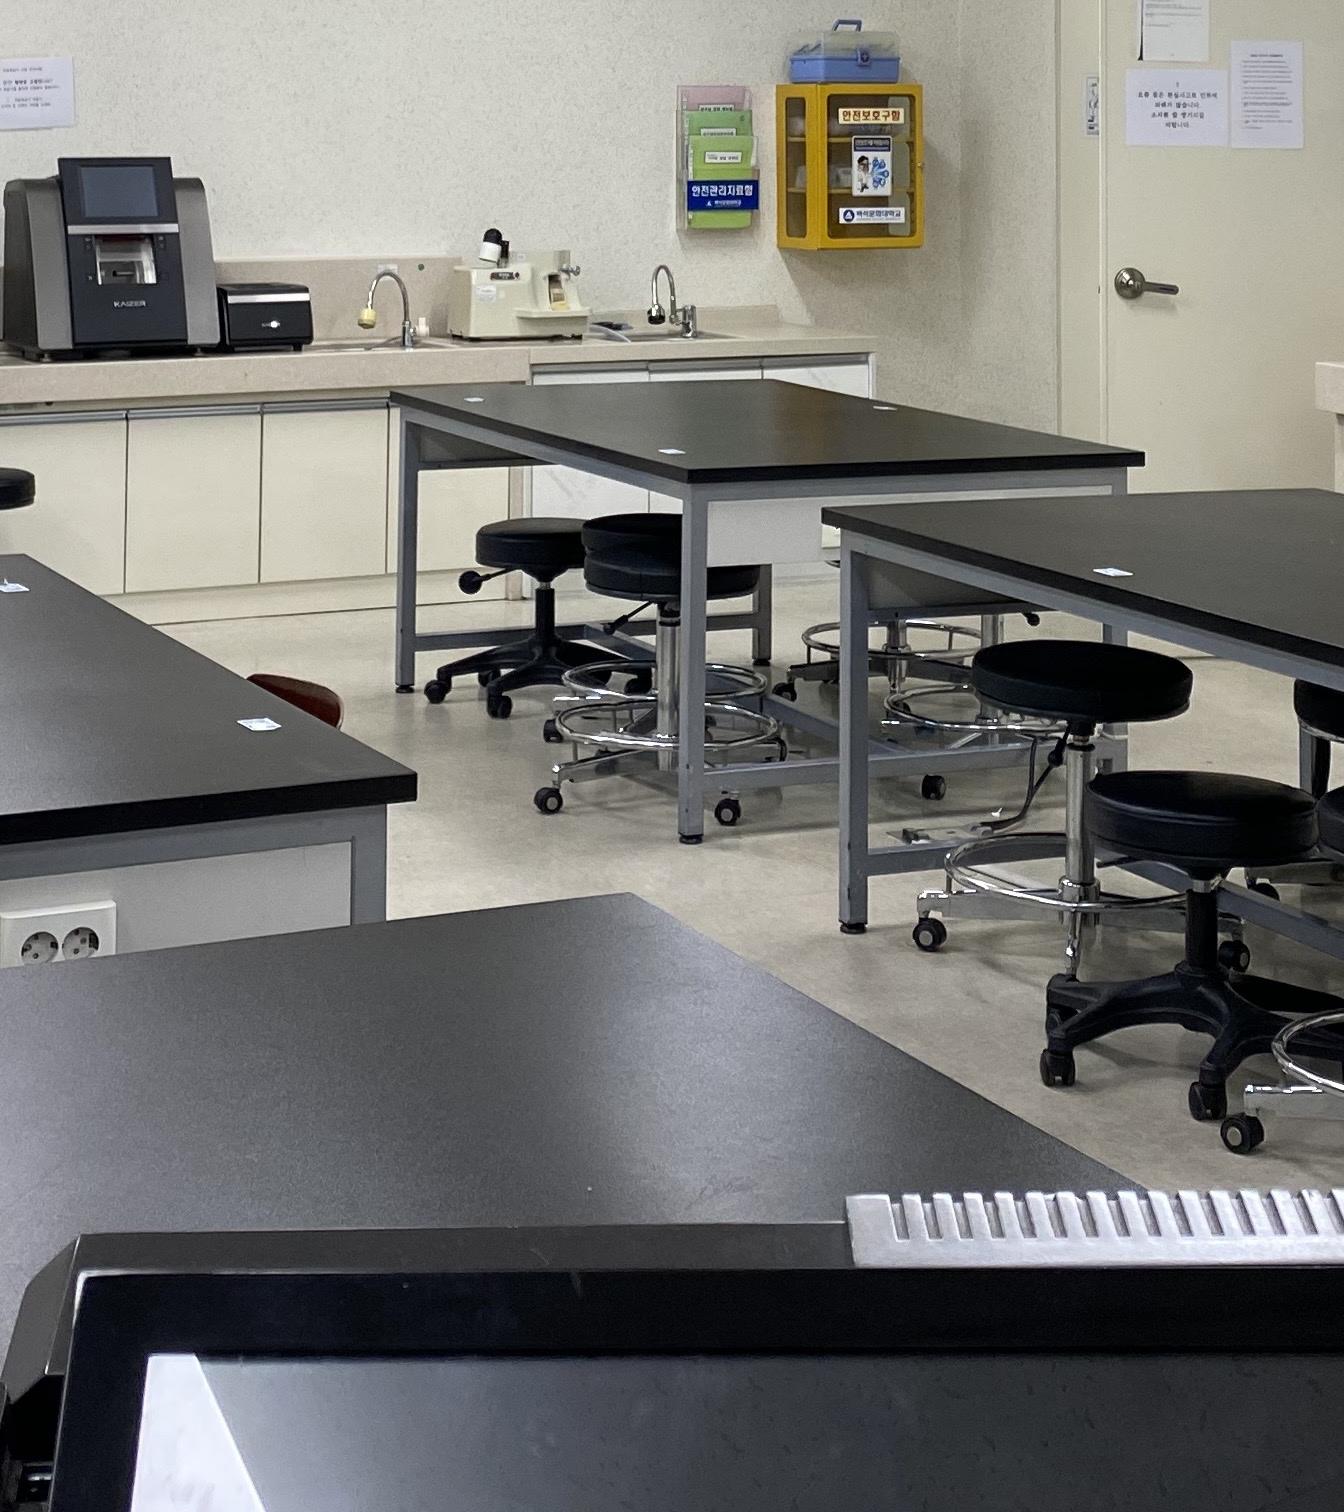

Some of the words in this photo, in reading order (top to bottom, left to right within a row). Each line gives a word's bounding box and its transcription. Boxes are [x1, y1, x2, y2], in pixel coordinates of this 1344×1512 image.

[842, 110, 901, 122] 안전보호구함
[691, 184, 753, 197] 안전관리자료함
[113, 300, 147, 308] KAIZER
